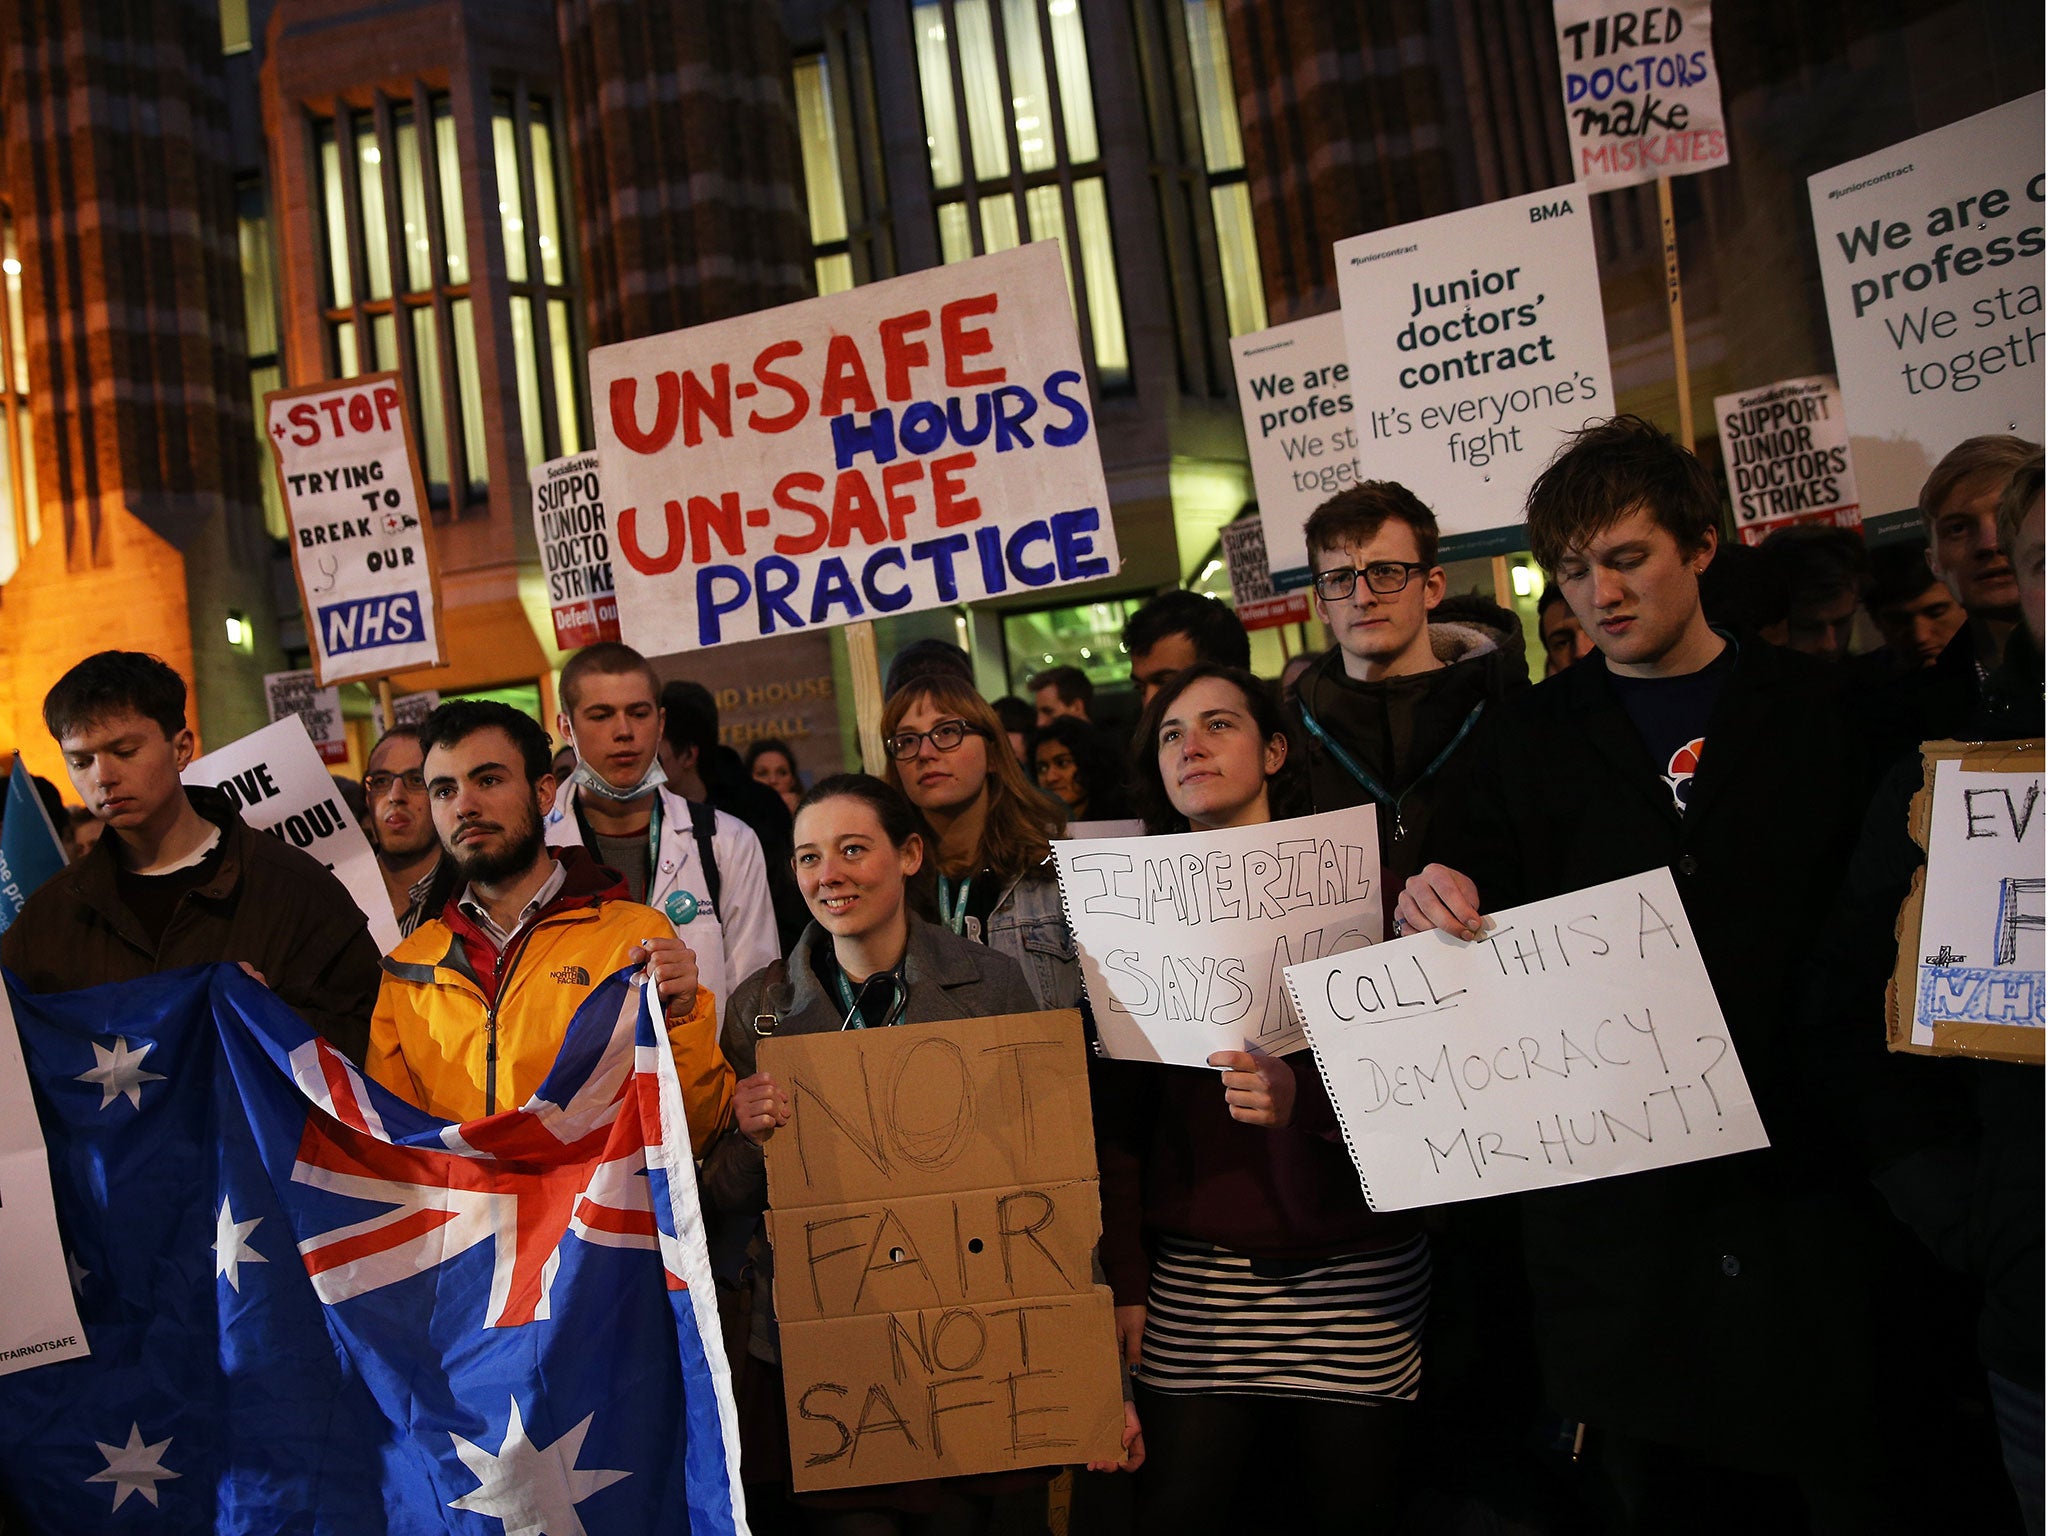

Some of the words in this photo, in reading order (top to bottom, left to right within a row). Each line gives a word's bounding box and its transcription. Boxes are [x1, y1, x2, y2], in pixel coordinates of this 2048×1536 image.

[1564, 7, 1684, 61] TIRED
[1566, 50, 1708, 104] DOCTORS
[1573, 94, 1690, 139] make
[1581, 130, 1726, 175] MISKATES
[1828, 163, 1915, 200] #juniorcontract
[1529, 200, 1573, 223] BMA
[1837, 220, 1912, 265] We
[1926, 188, 2011, 237] are
[1350, 243, 1418, 267] #juniorcontract
[1411, 266, 1521, 317] Junior
[1397, 294, 1545, 352] doctors'
[1885, 307, 1958, 350] We
[1974, 285, 2043, 328] sta
[610, 293, 1006, 455] UN-SAFE
[1250, 371, 1295, 401] We
[1303, 362, 1349, 391] are
[1399, 333, 1555, 390] contract
[288, 387, 399, 447] STOP
[830, 370, 1089, 470] HOURS
[1260, 393, 1354, 438] profes
[1370, 406, 1412, 440] It's
[1420, 371, 1597, 425] everyone's
[1726, 394, 1829, 439] SUPPORT
[1281, 436, 1324, 462] We
[1331, 425, 1358, 451] st
[1448, 425, 1523, 468] fight
[1733, 425, 1813, 467] JUNIOR
[288, 460, 384, 497] TRYING
[538, 472, 600, 513] SUPPO
[547, 462, 582, 479] Socialist
[363, 489, 400, 512] TO
[542, 502, 606, 543] JUNIOR
[617, 451, 981, 576] UN-SAFE
[1740, 477, 1840, 520] STRIKES
[300, 518, 373, 547] BREAK
[546, 533, 608, 572] DOCTO
[367, 546, 415, 573] OUR
[551, 563, 615, 602] STRIKE
[696, 507, 1109, 647] PRACTICE
[328, 598, 414, 653] NHS
[746, 676, 832, 706] HOUSE
[1965, 779, 2045, 842] EV
[1071, 838, 1370, 926] IMPERIAL
[1477, 914, 1609, 975] THIS
[1638, 892, 1679, 959] A
[1105, 948, 1253, 1025] SAYS
[1358, 1008, 1668, 1113] DEMOCRACY
[789, 1036, 1064, 1188] NOT
[1424, 1128, 1528, 1178] MR
[804, 1190, 1075, 1319] FAIR
[887, 1303, 1071, 1384] NOT
[798, 1369, 1078, 1468] SAFE
